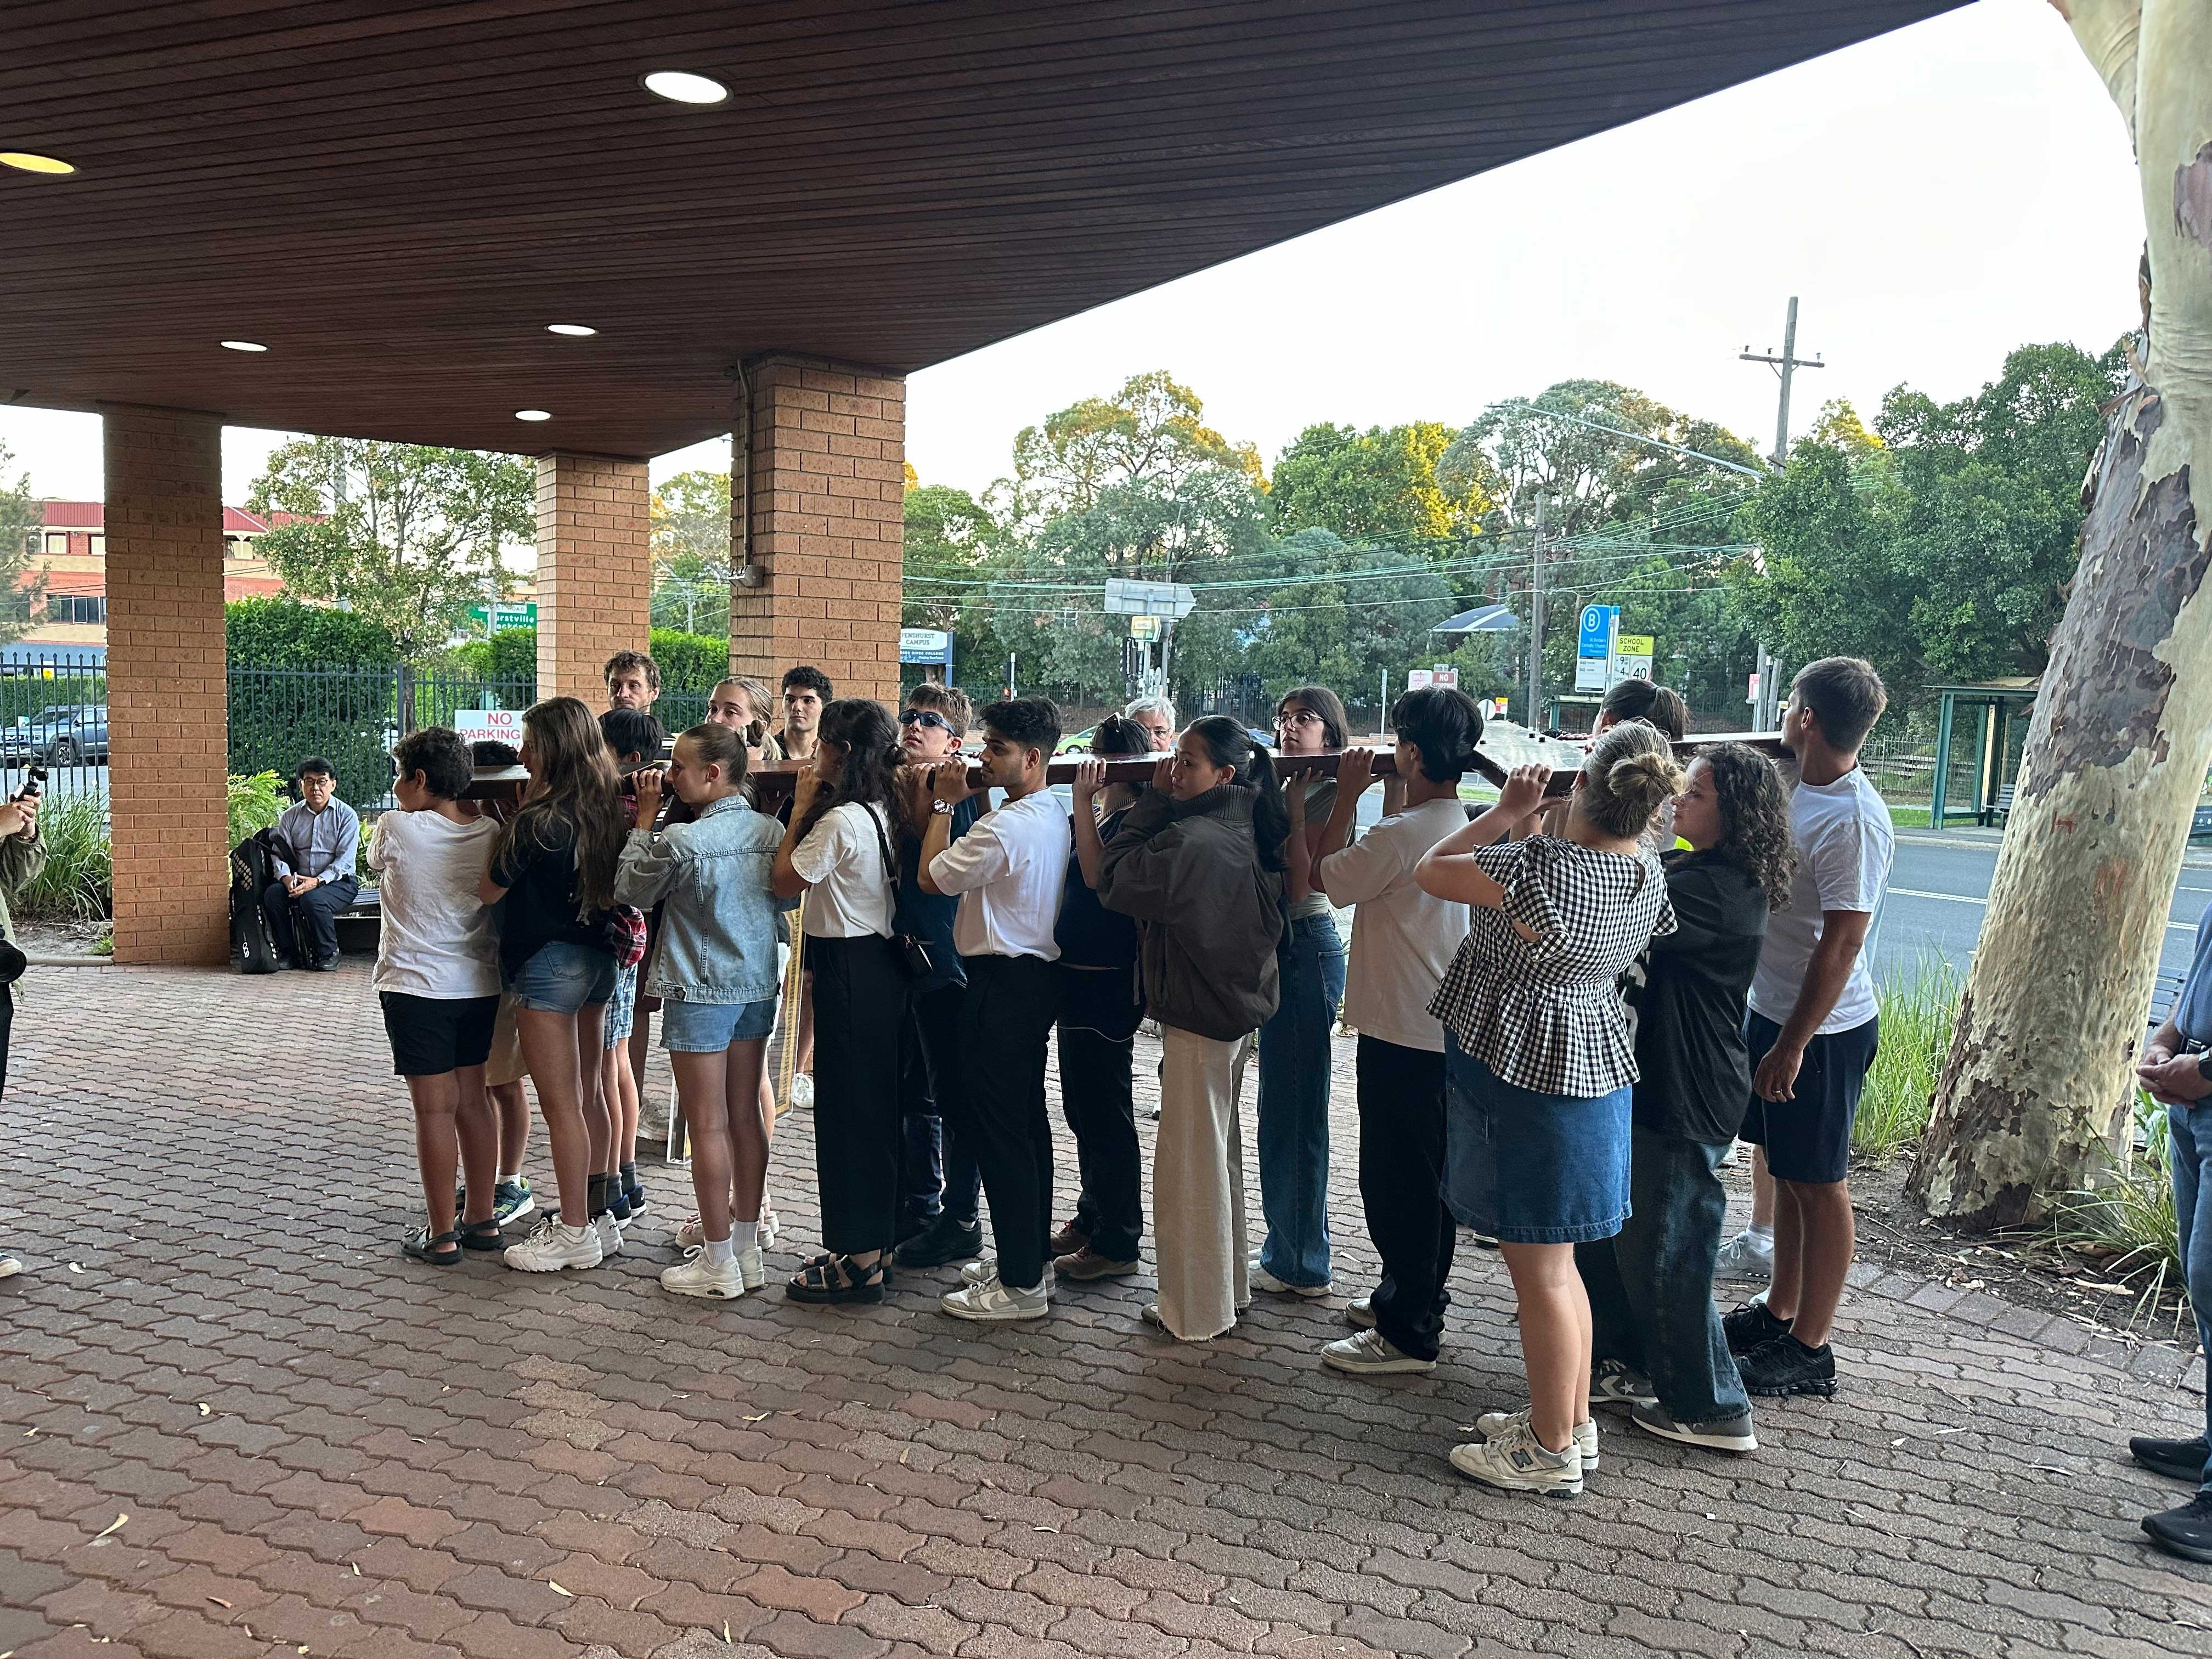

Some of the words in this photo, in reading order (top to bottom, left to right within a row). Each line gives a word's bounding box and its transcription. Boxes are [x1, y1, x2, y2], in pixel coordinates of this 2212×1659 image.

[496, 615, 535, 623] urstville
[1588, 613, 1596, 627] B
[1633, 667, 1647, 680] 40
[488, 713, 512, 725] NO
[460, 729, 521, 740] PARKING
[1510, 1448, 1533, 1469] N
